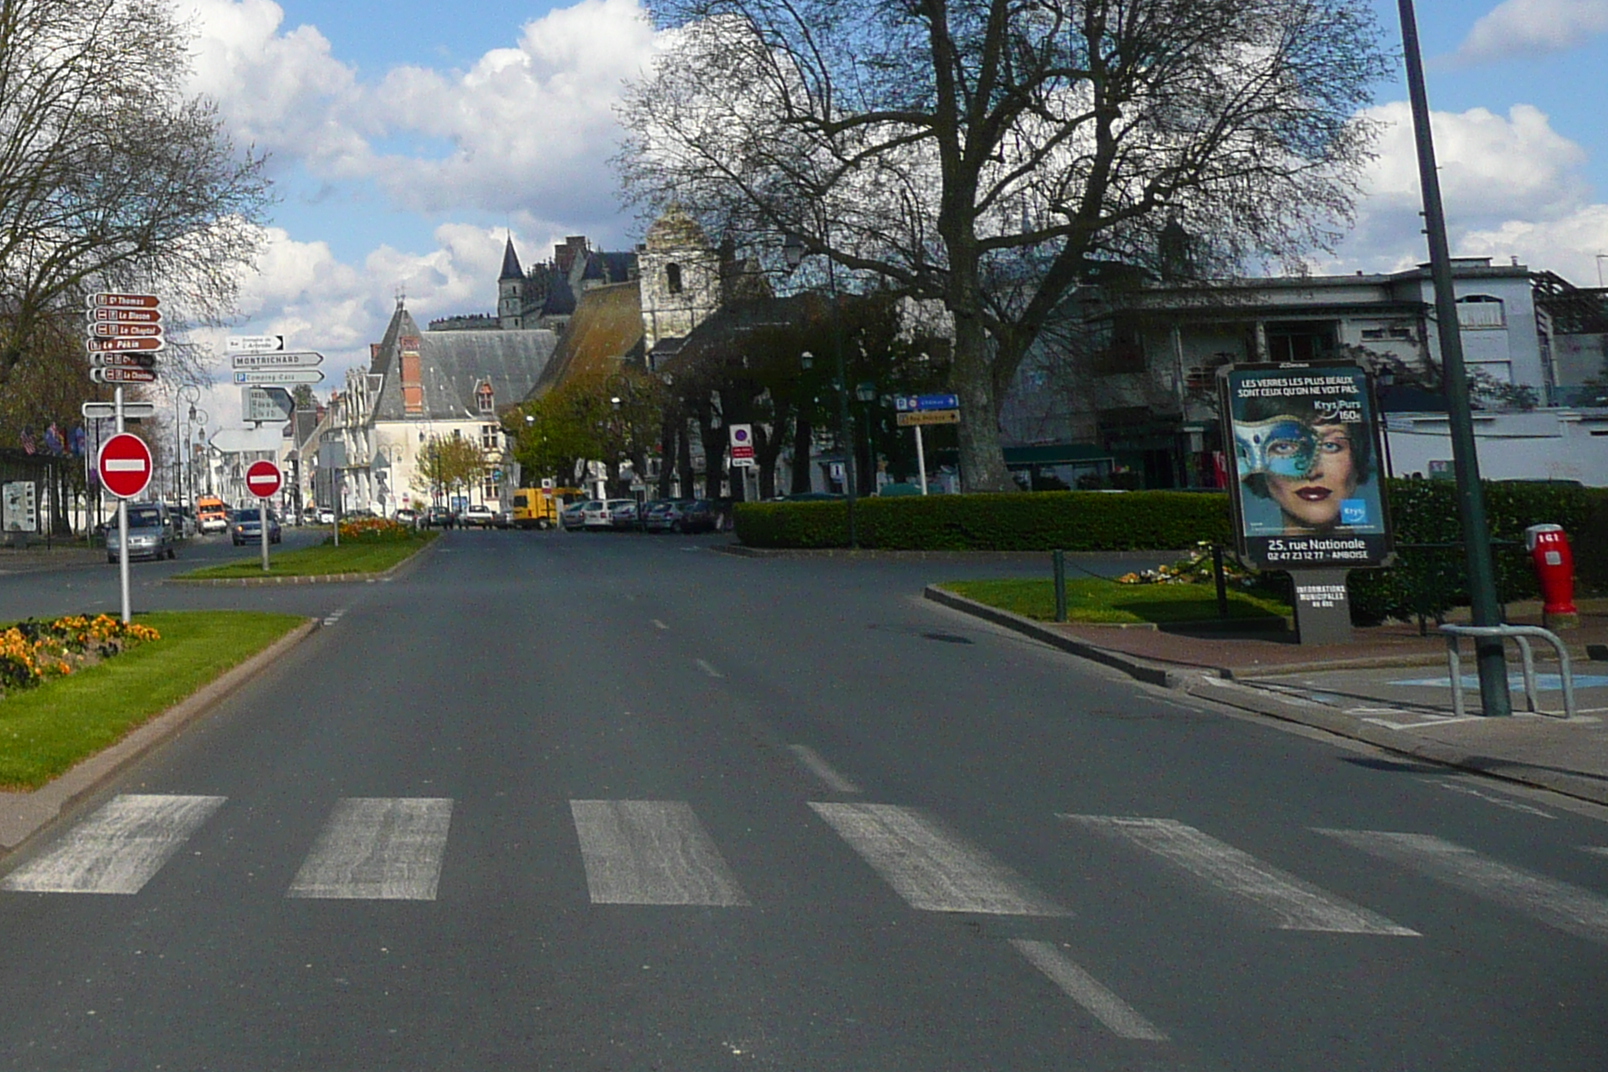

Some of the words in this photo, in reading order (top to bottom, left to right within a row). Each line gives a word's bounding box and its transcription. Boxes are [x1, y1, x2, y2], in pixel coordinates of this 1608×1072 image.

[118, 297, 145, 305] Thomas
[119, 312, 127, 320] Le
[120, 326, 129, 334] Le
[103, 341, 113, 349] Le
[117, 340, 140, 349] Pékin
[236, 356, 299, 365] MONTRICHARD
[1241, 379, 1256, 388] LES
[1257, 378, 1288, 388] VERRES
[1289, 377, 1303, 386] LES
[1305, 377, 1325, 386] PLUS
[1326, 376, 1353, 385] BEAUX
[1237, 388, 1260, 398] SONT
[1261, 387, 1282, 397] CEUX
[1283, 387, 1308, 396] QU'ON
[1310, 386, 1321, 395] NE
[1322, 385, 1340, 395] VOIT
[1341, 384, 1360, 394] PAS.
[1314, 400, 1337, 411] Krys
[1339, 400, 1361, 409] Purs
[1344, 507, 1365, 518] Krys
[1289, 541, 1309, 550] rue
[1310, 538, 1365, 550] Nationale
[1267, 552, 1279, 560] 02
[1280, 552, 1290, 560] 47
[1292, 552, 1303, 560] 23
[1303, 552, 1313, 560] 12
[1314, 551, 1324, 559] 77
[1331, 551, 1369, 559] AMBOISE
[1296, 585, 1346, 593] INFORMATIONS
[1299, 593, 1345, 601] MUNICIPALES
